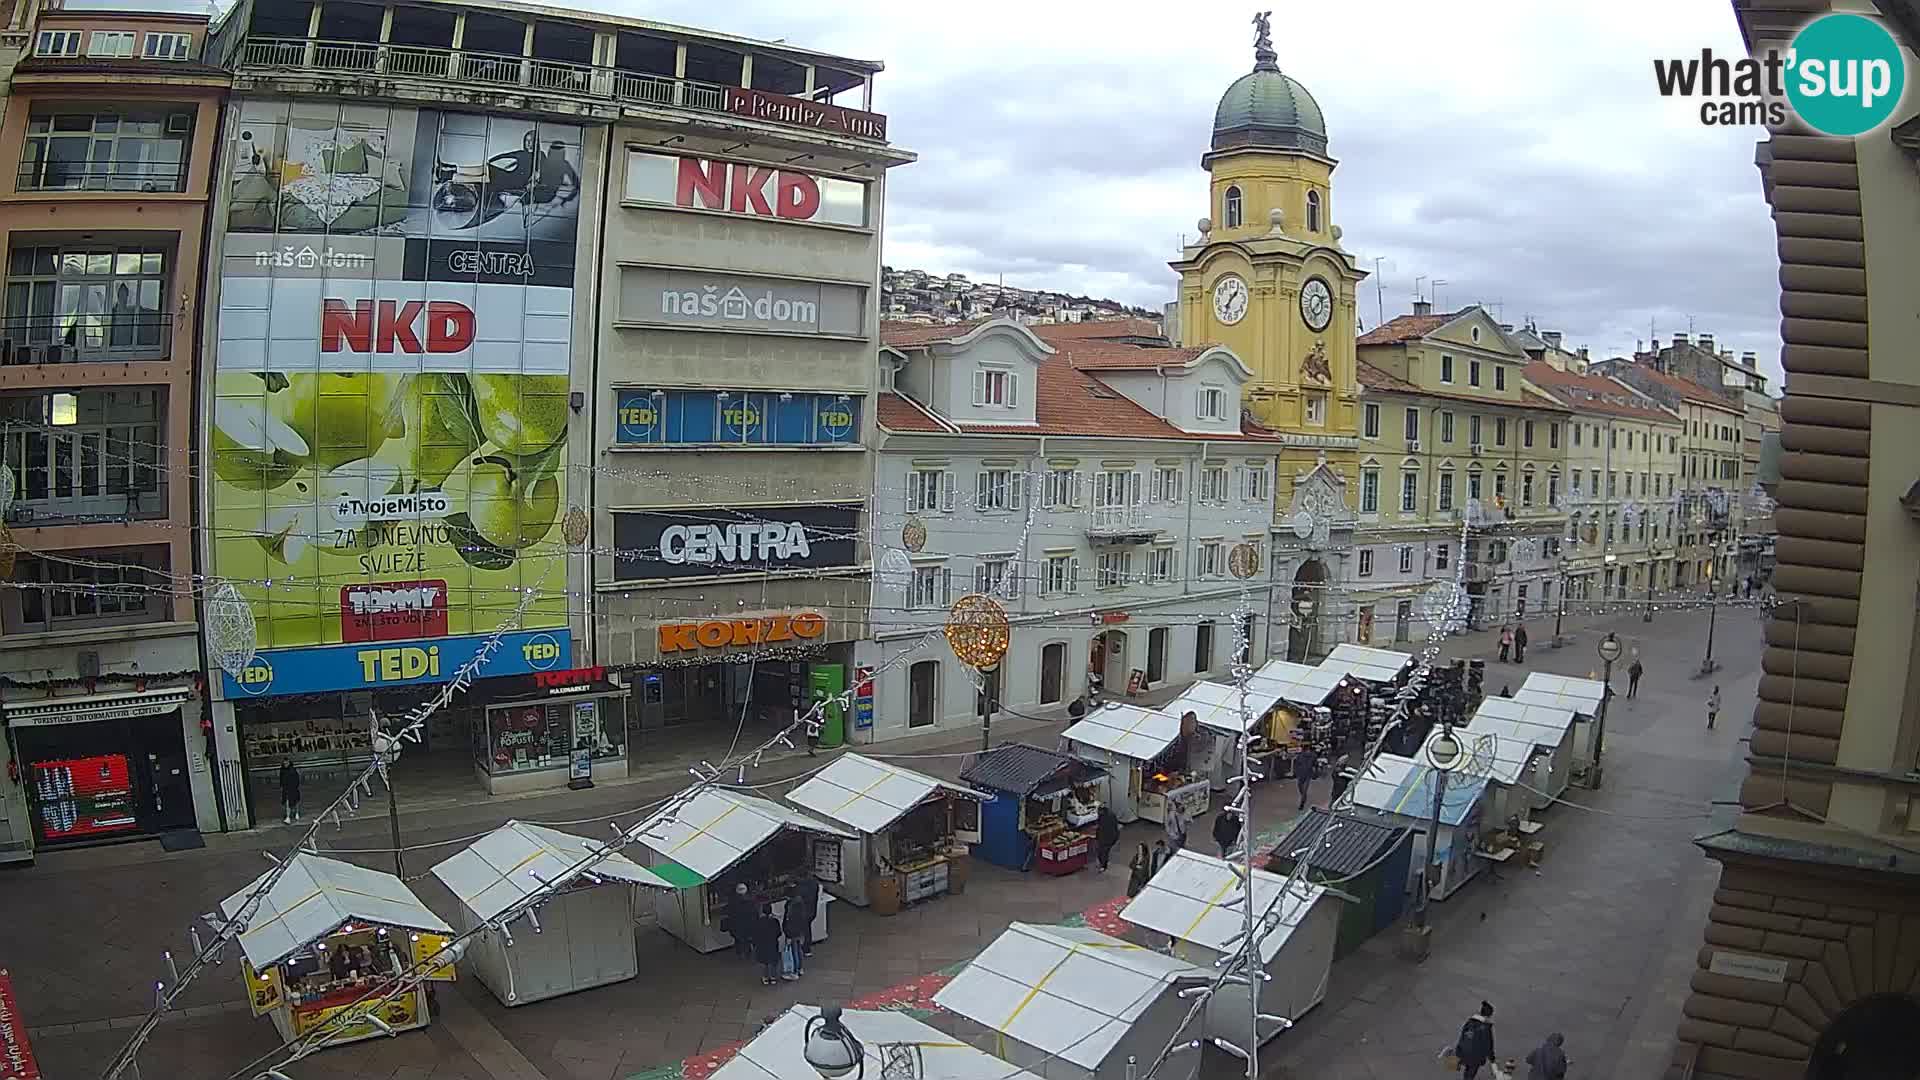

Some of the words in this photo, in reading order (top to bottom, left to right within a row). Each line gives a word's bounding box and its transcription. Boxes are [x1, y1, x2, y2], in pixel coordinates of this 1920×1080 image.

[723, 87, 745, 114] Le
[676, 157, 821, 221] NKD
[447, 249, 536, 277] CENTRA
[662, 284, 718, 317] naš
[753, 289, 817, 323] dom
[320, 297, 477, 355] NKD
[618, 406, 658, 426] TEDi
[723, 408, 760, 426] TEDi
[819, 410, 853, 427] TEDi
[338, 496, 448, 516] #TvojeMisto
[334, 527, 357, 549] ZA
[366, 525, 451, 548] DNEVNO
[659, 521, 811, 565] CENTRA
[359, 547, 427, 576] SVJEŽE
[348, 587, 440, 615] TOMMY
[658, 612, 829, 654] KORZO
[358, 646, 440, 683] TEDi
[522, 643, 560, 662] TEDi
[236, 665, 274, 686] TEDi
